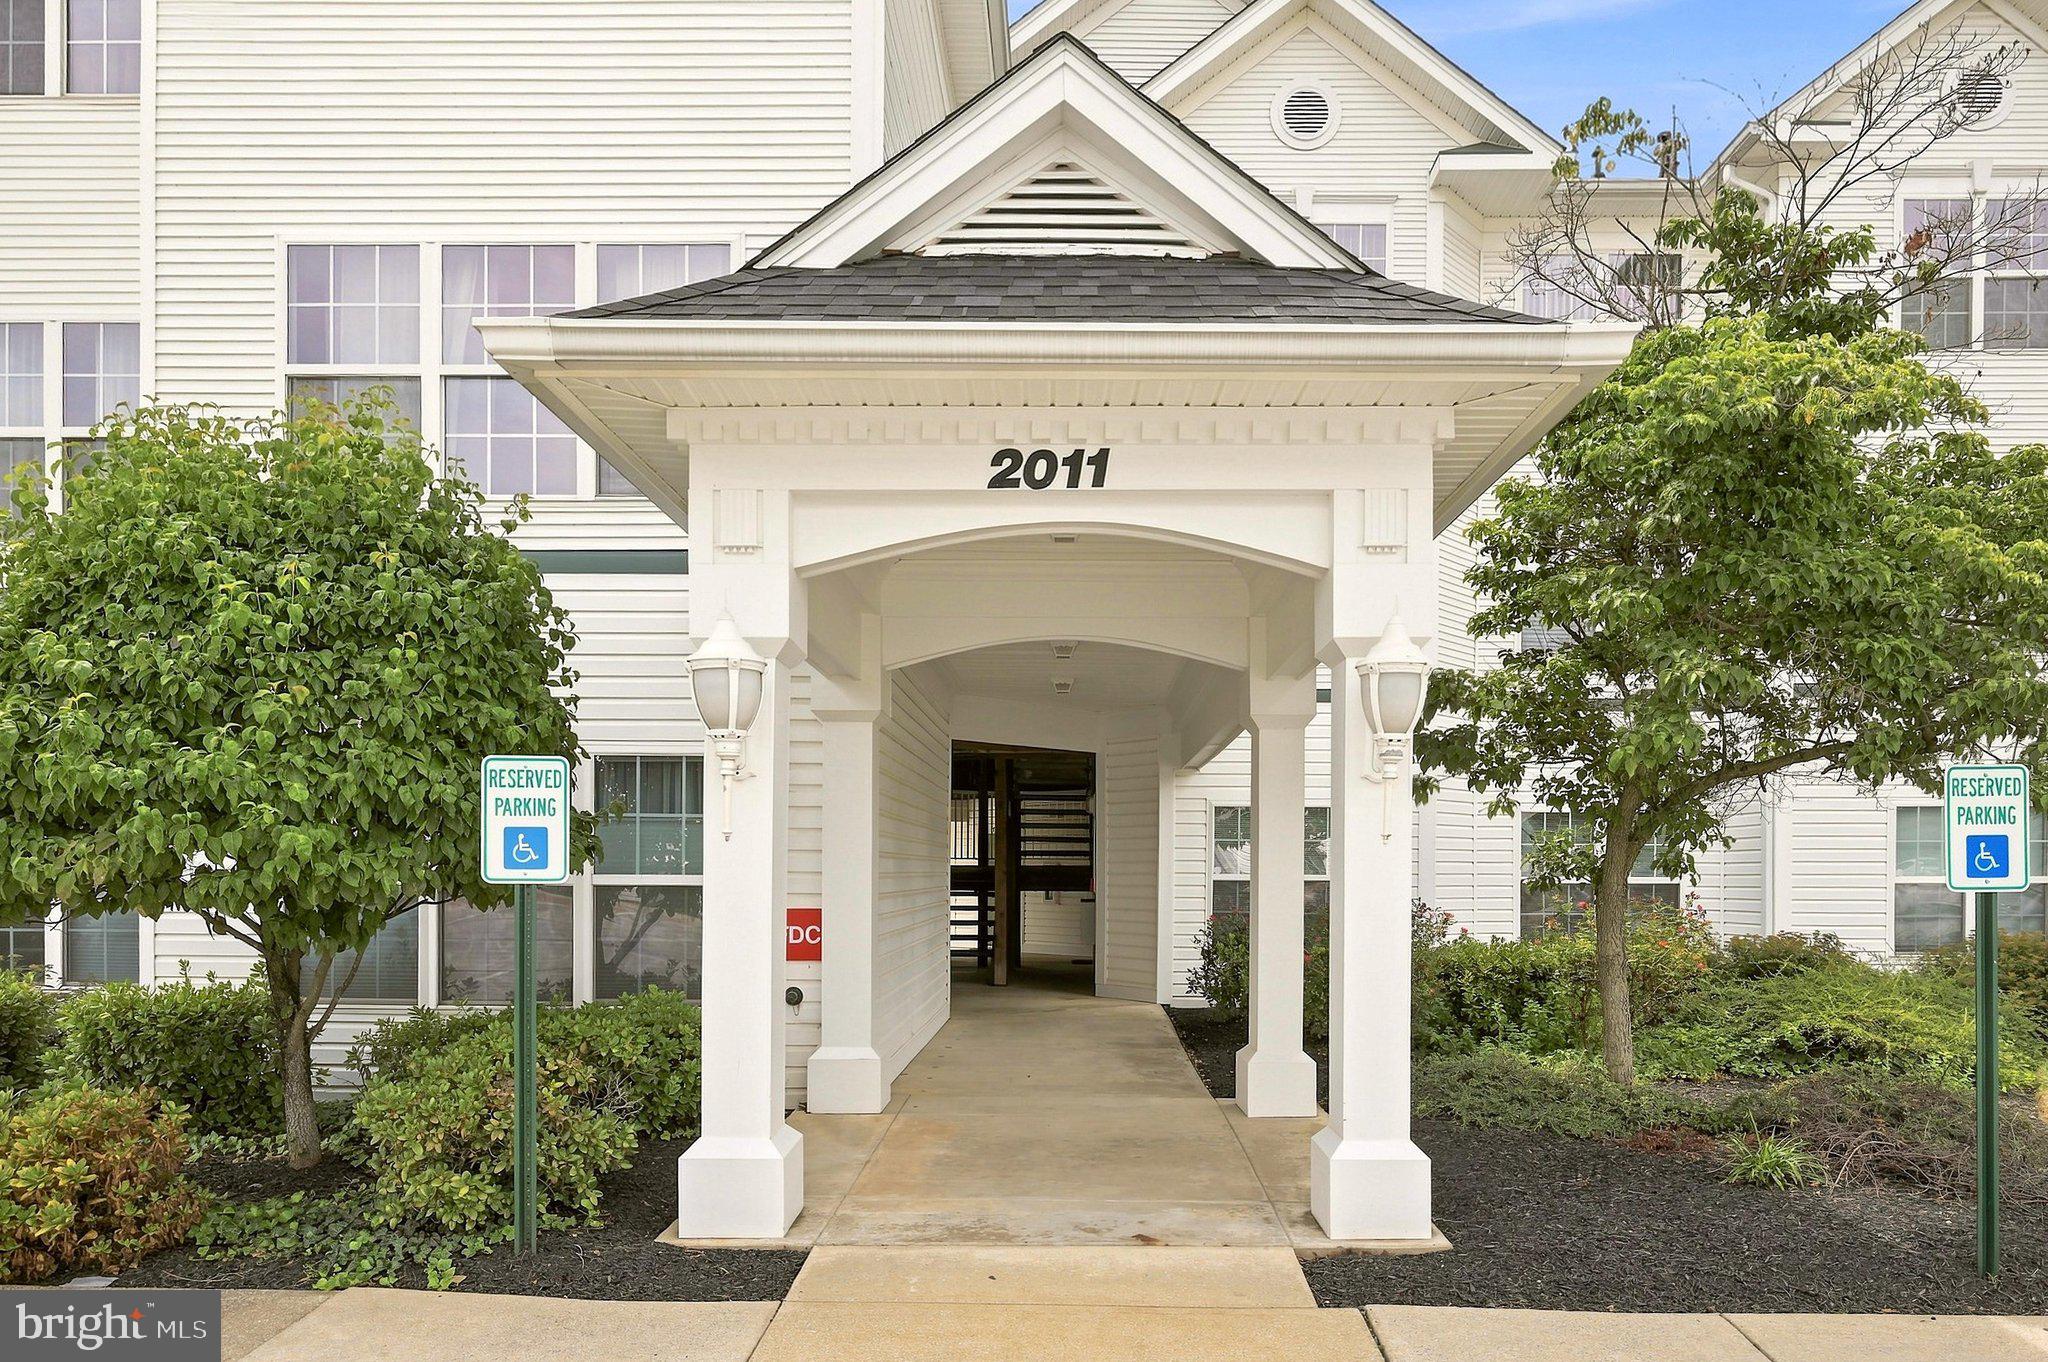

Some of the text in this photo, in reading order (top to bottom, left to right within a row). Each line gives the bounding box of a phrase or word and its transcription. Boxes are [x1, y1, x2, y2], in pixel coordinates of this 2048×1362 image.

[987, 448, 1110, 490] 2011
[489, 769, 562, 789] RESERVED
[1952, 777, 2021, 797] RESERVED
[495, 798, 556, 817] PARKING
[1957, 806, 2016, 825] PARKING
[786, 925, 821, 944] DC
